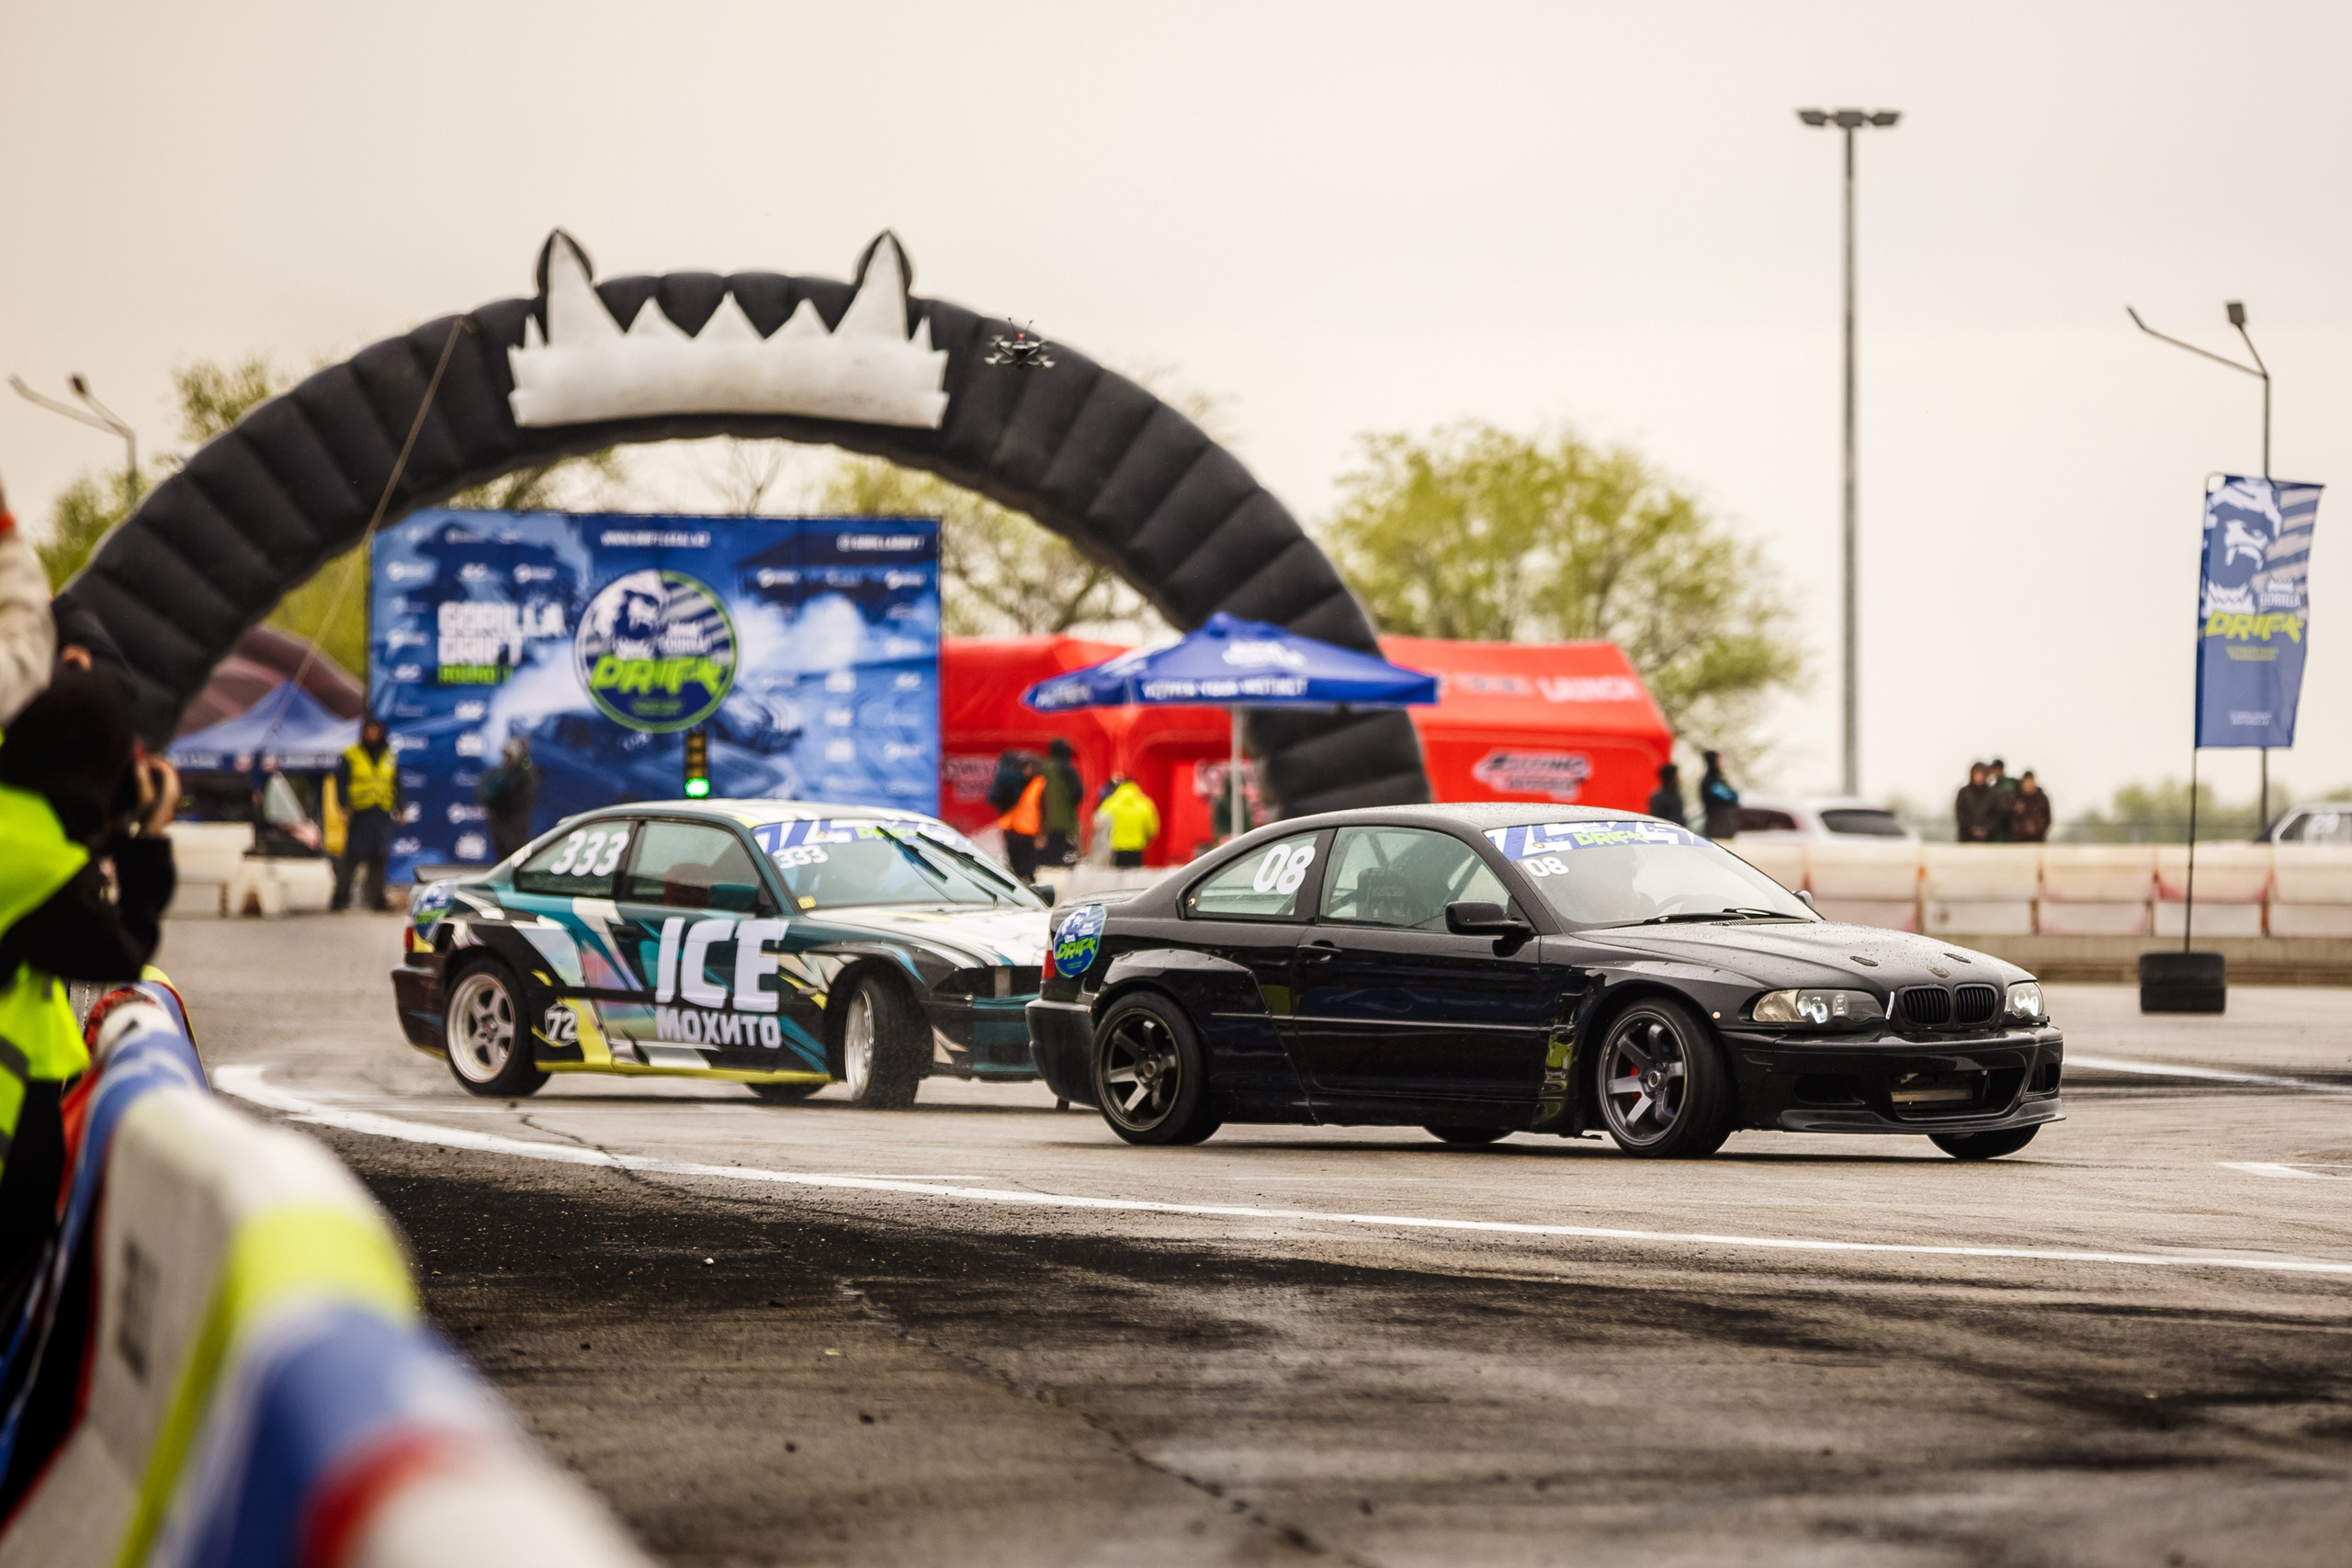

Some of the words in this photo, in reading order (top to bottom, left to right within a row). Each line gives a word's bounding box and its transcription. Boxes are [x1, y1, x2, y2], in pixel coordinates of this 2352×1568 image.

[2259, 592, 2301, 607] GORILLA
[2206, 610, 2304, 644] DRIFT
[590, 654, 722, 696] DRIFT
[549, 829, 630, 877] 333
[1572, 830, 1651, 846] DRIFT
[773, 845, 829, 870] 333
[1252, 844, 1316, 895] 08
[1522, 856, 1569, 877] 08
[655, 917, 790, 1012] ICE
[1057, 938, 1096, 961] DRIFT
[547, 1010, 576, 1041] 72
[655, 1005, 782, 1049] МОХИТО
